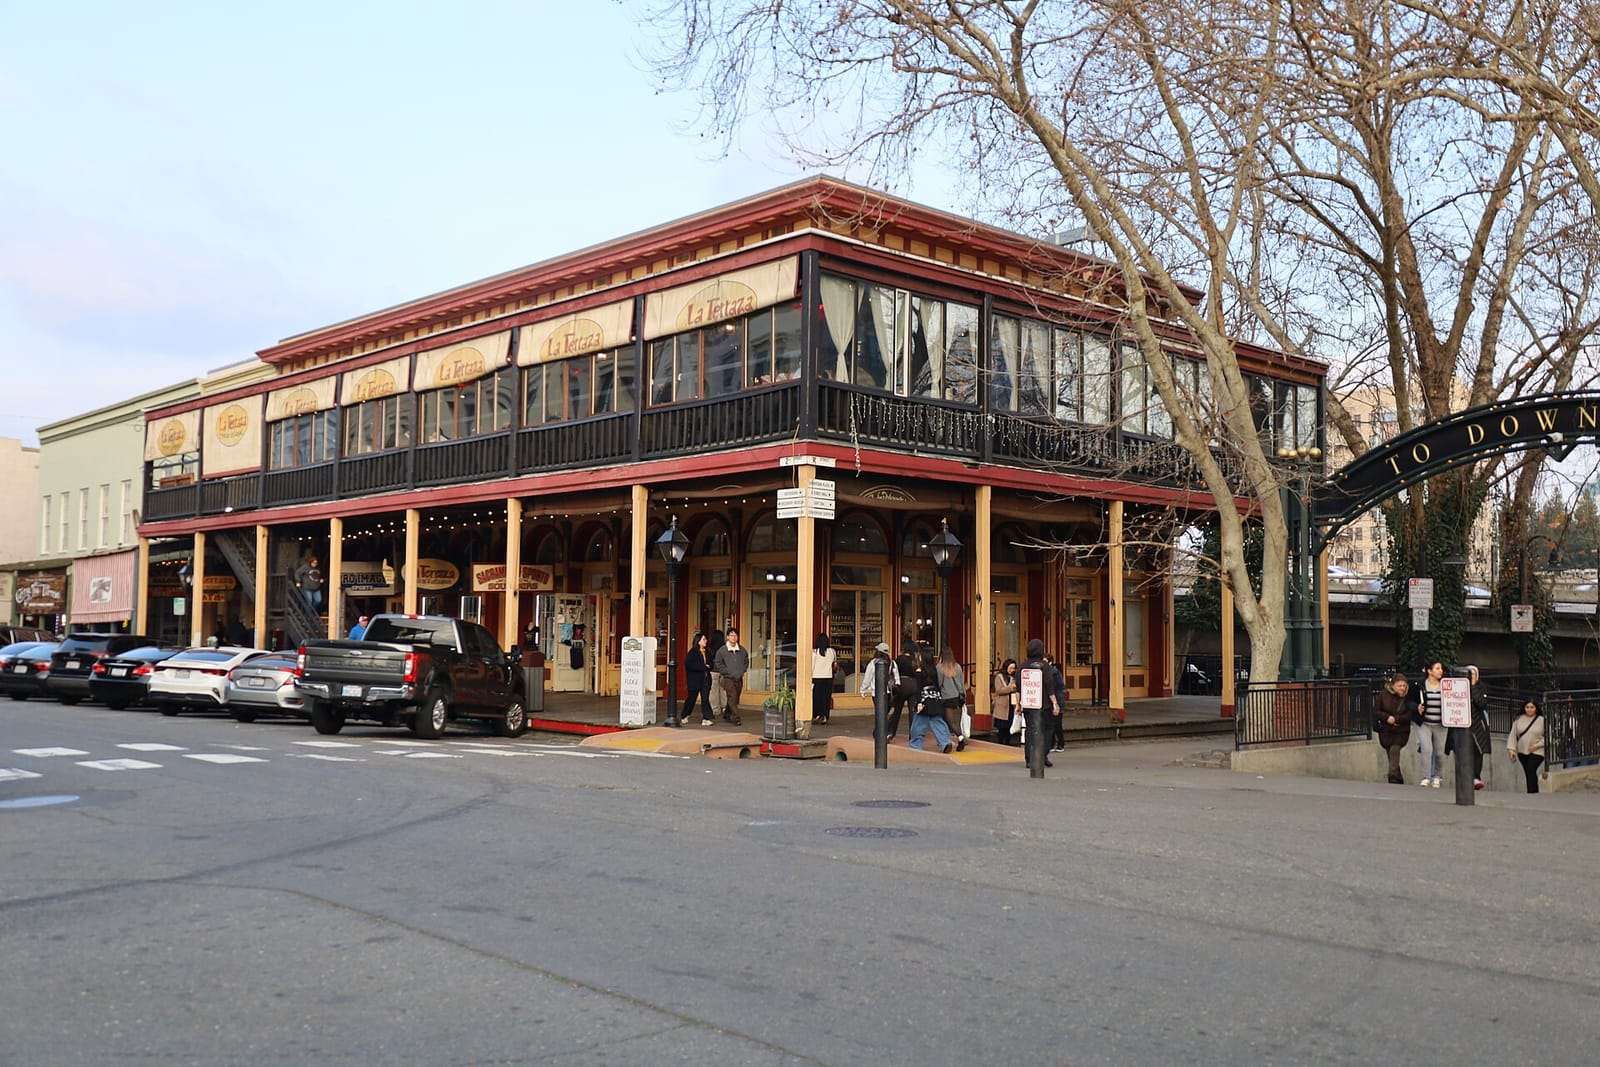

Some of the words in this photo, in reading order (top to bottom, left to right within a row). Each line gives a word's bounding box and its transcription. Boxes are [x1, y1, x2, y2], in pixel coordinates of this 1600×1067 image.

[687, 304, 703, 326] La
[707, 295, 753, 321] Terraza
[548, 337, 561, 357] La
[564, 332, 600, 353] Terraza
[440, 363, 451, 381] La
[453, 359, 484, 378] Terraza
[357, 383, 366, 400] La
[367, 380, 395, 398] Terraza
[1386, 442, 1431, 476] TO
[1466, 405, 1598, 446] DOWN
[341, 574, 354, 584] RO
[356, 573, 386, 584] IMAG
[1023, 680, 1041, 688] PARKING
[1442, 679, 1452, 691] NO
[1443, 691, 1468, 699] VEHICLES
